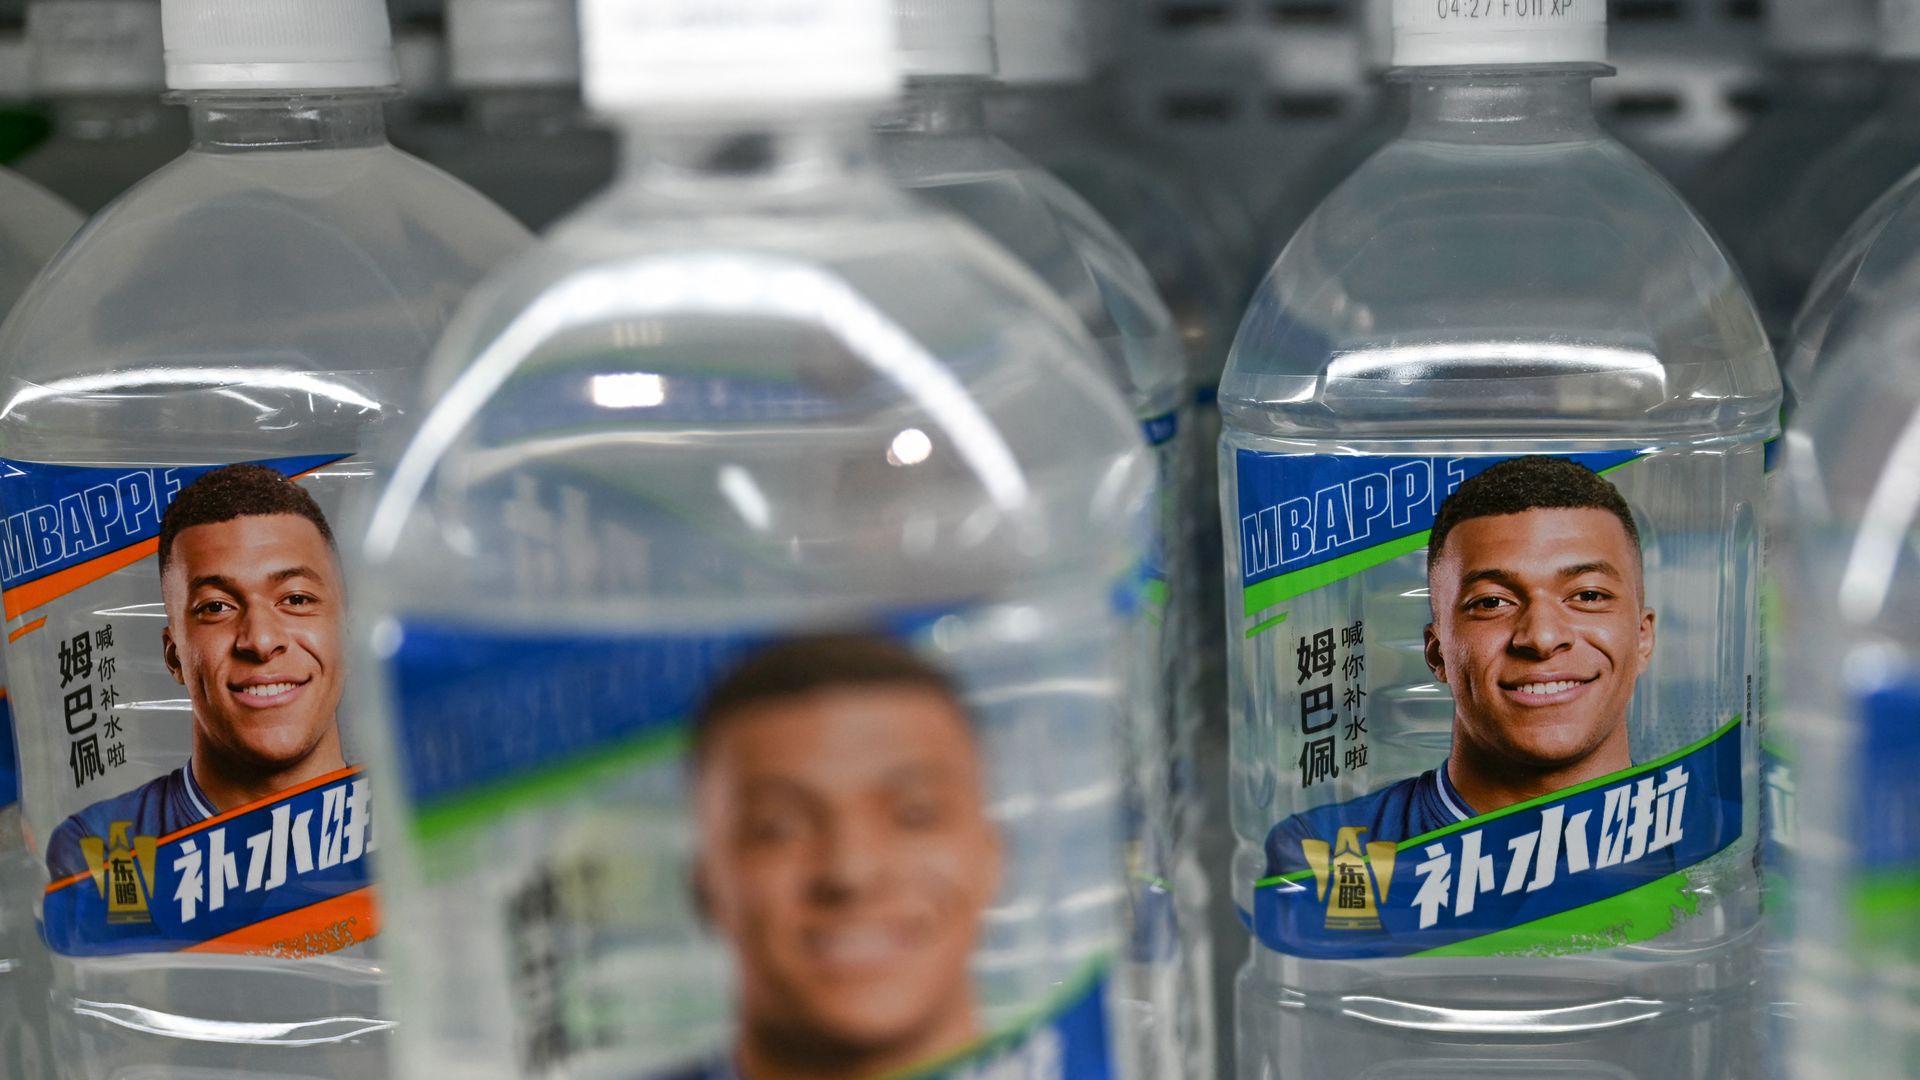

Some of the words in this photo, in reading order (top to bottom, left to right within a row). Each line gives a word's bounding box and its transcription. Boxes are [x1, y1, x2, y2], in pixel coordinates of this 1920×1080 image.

[58, 631, 105, 788] 姆巴佩
[95, 624, 127, 768] 喊你补水啦
[1297, 628, 1340, 788] 姆巴佩
[1341, 620, 1369, 771] 喊你补水啦
[1337, 862, 1366, 909] 东鹏
[1410, 764, 1690, 930] 补水啦
